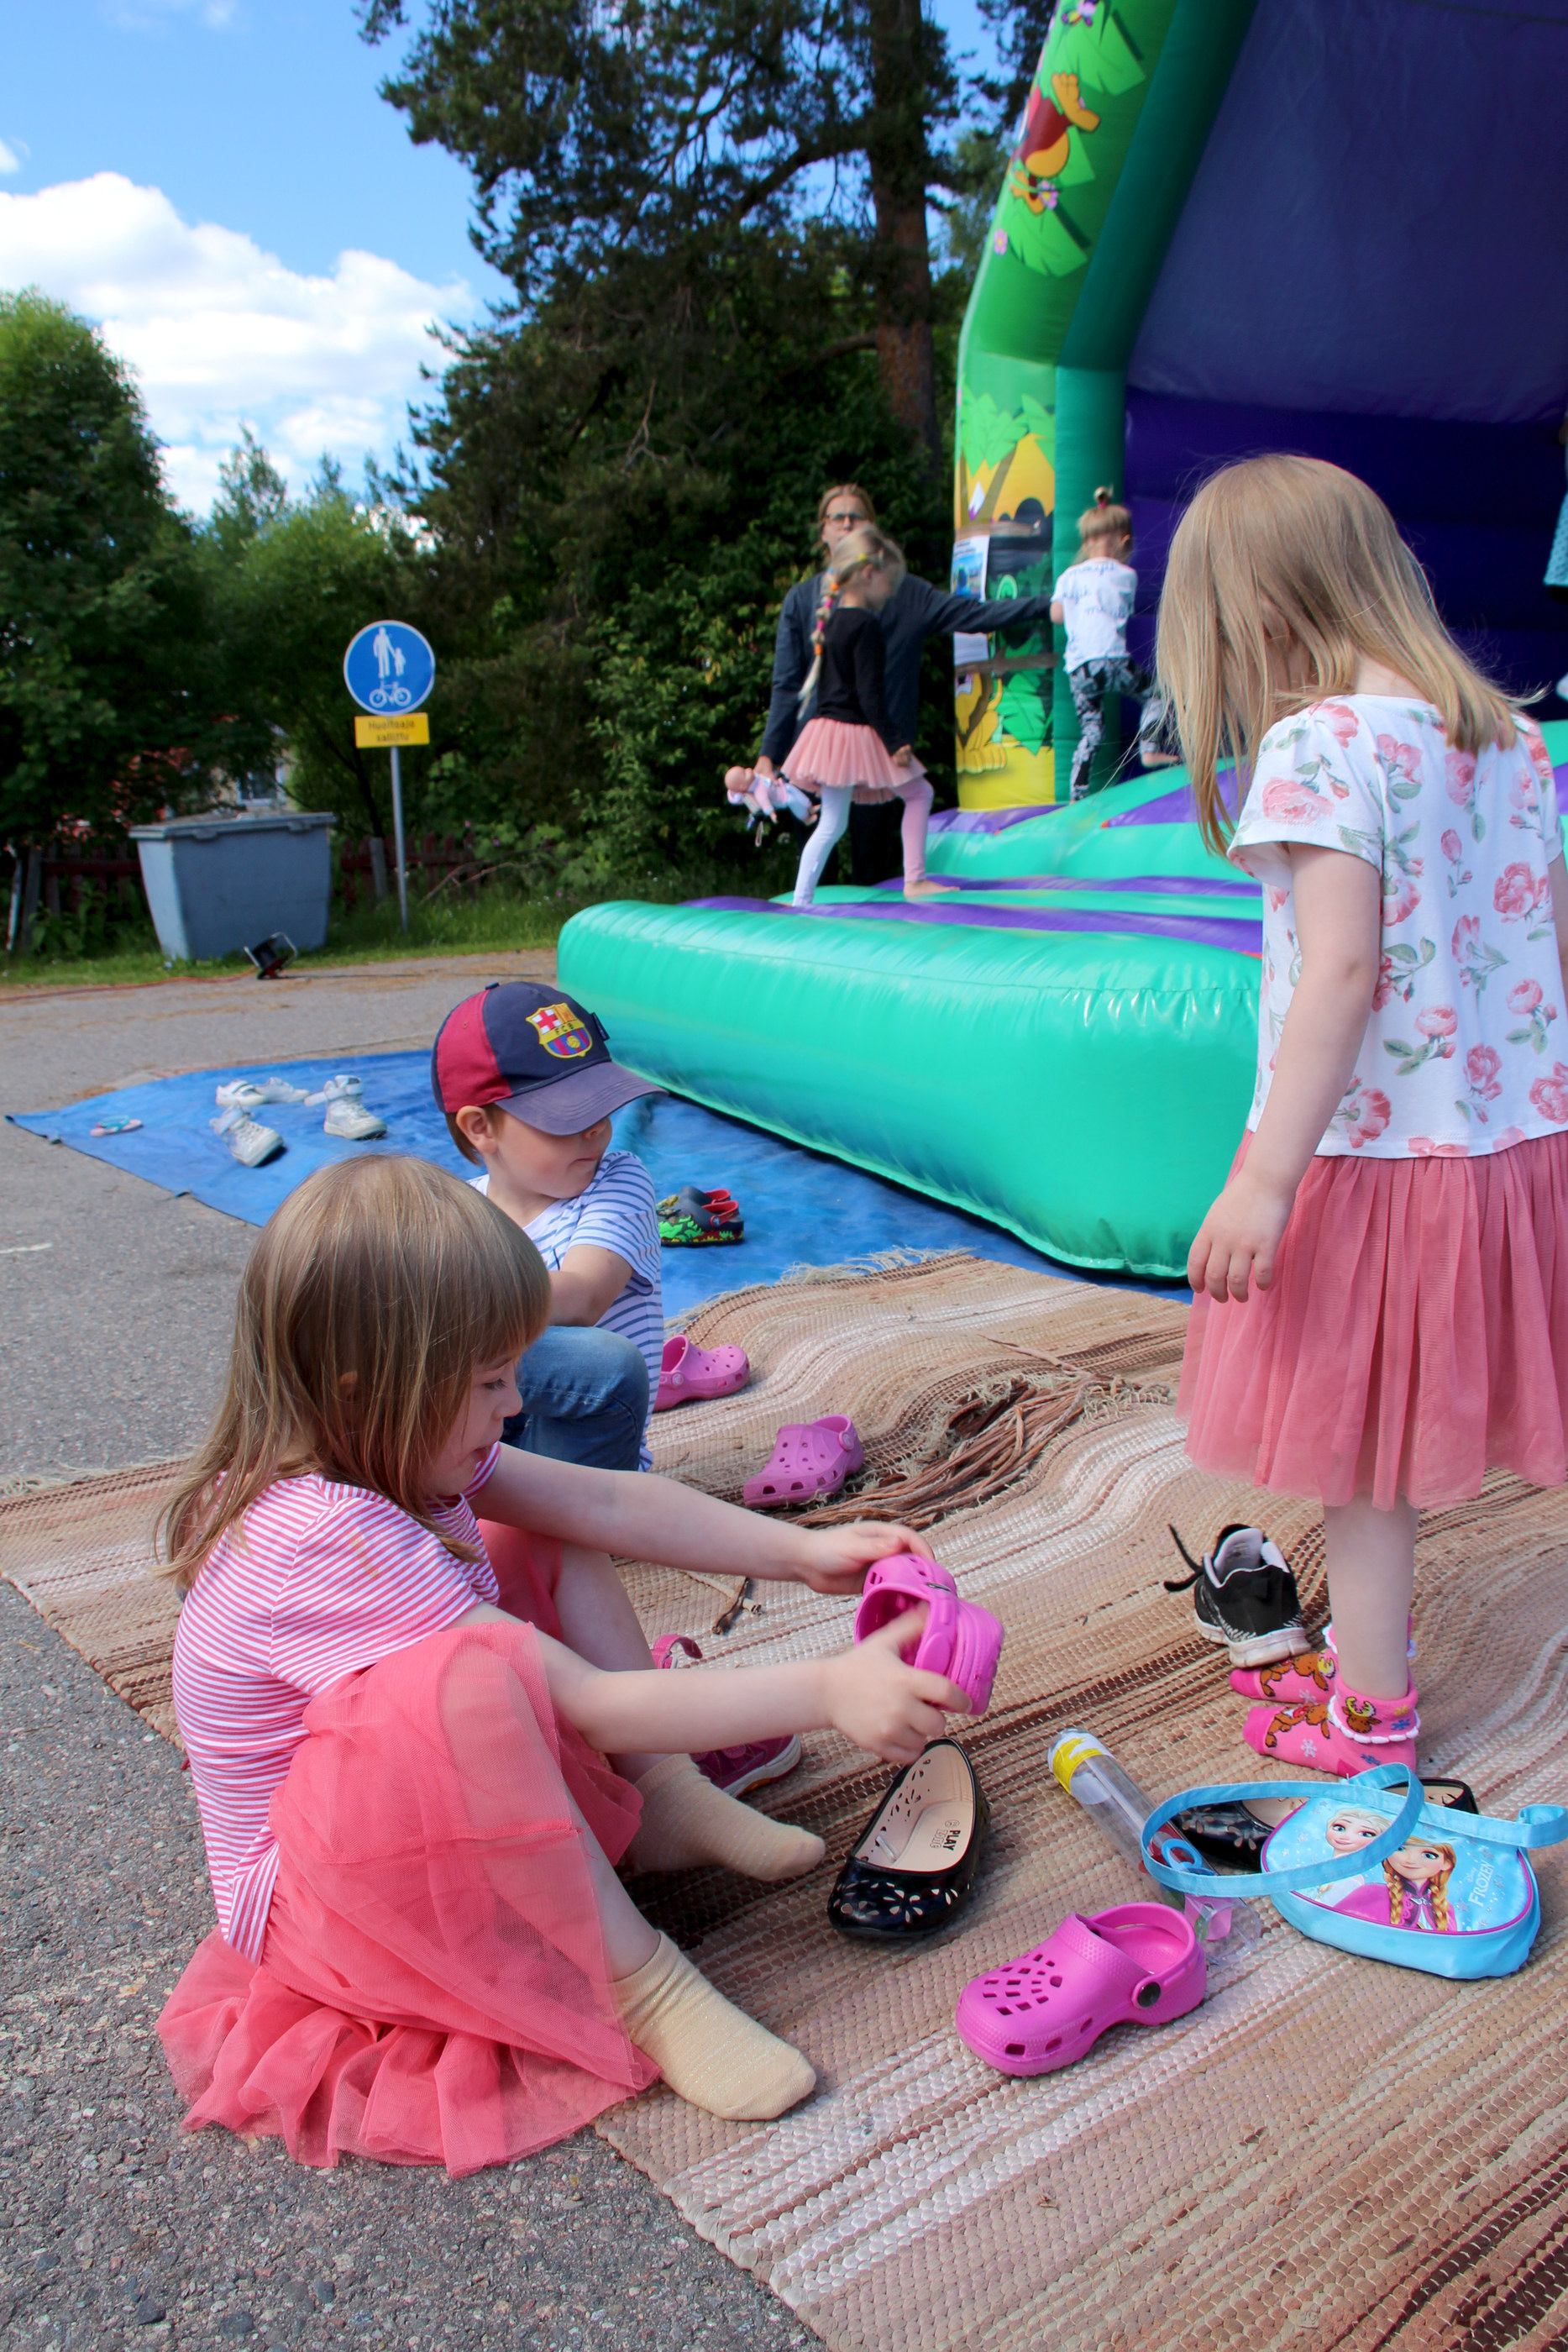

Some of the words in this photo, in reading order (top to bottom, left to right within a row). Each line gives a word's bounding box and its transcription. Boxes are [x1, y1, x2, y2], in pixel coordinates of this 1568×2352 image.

[554, 1021, 574, 1036] FCB
[942, 1830, 962, 1851] PLAY
[1467, 1859, 1495, 1908] FROZEN
